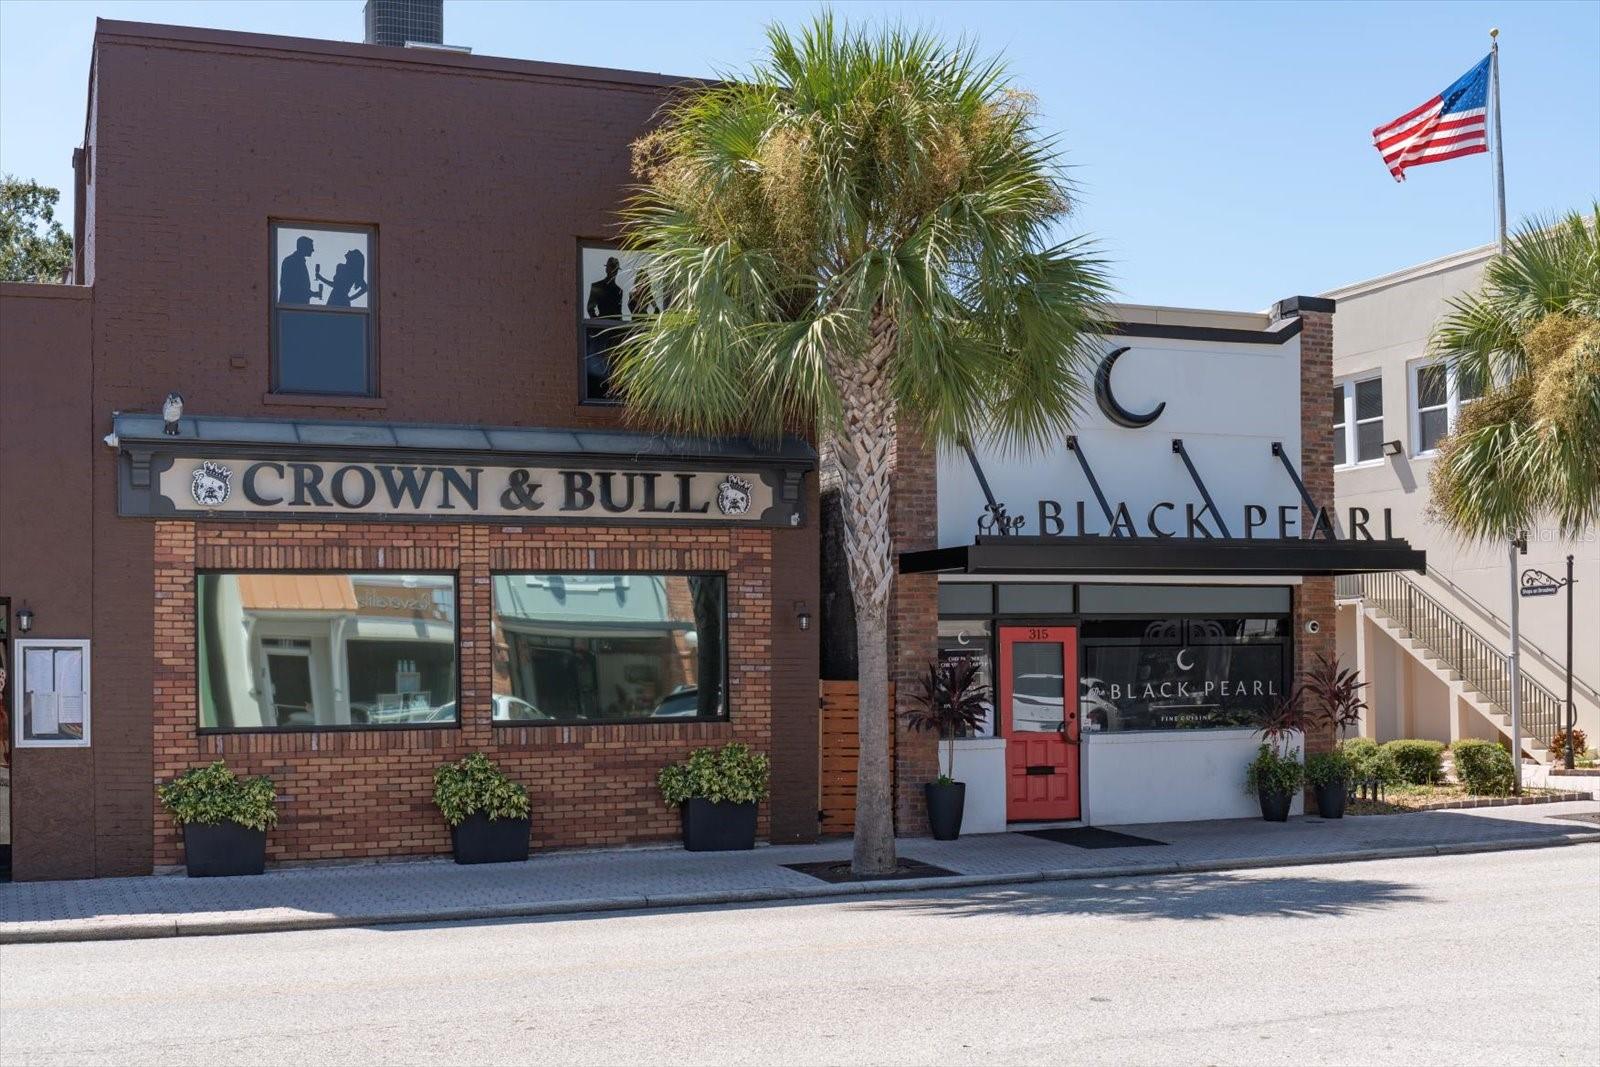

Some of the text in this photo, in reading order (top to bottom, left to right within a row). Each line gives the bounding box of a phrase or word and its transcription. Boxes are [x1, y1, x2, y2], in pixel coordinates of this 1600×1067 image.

[242, 461, 711, 513] CROWN & BULL
[978, 500, 1405, 541] The BLACK PEARL
[1028, 629, 1049, 640] 315
[1110, 681, 1191, 700] BLACK
[1203, 680, 1279, 698] PEARL
